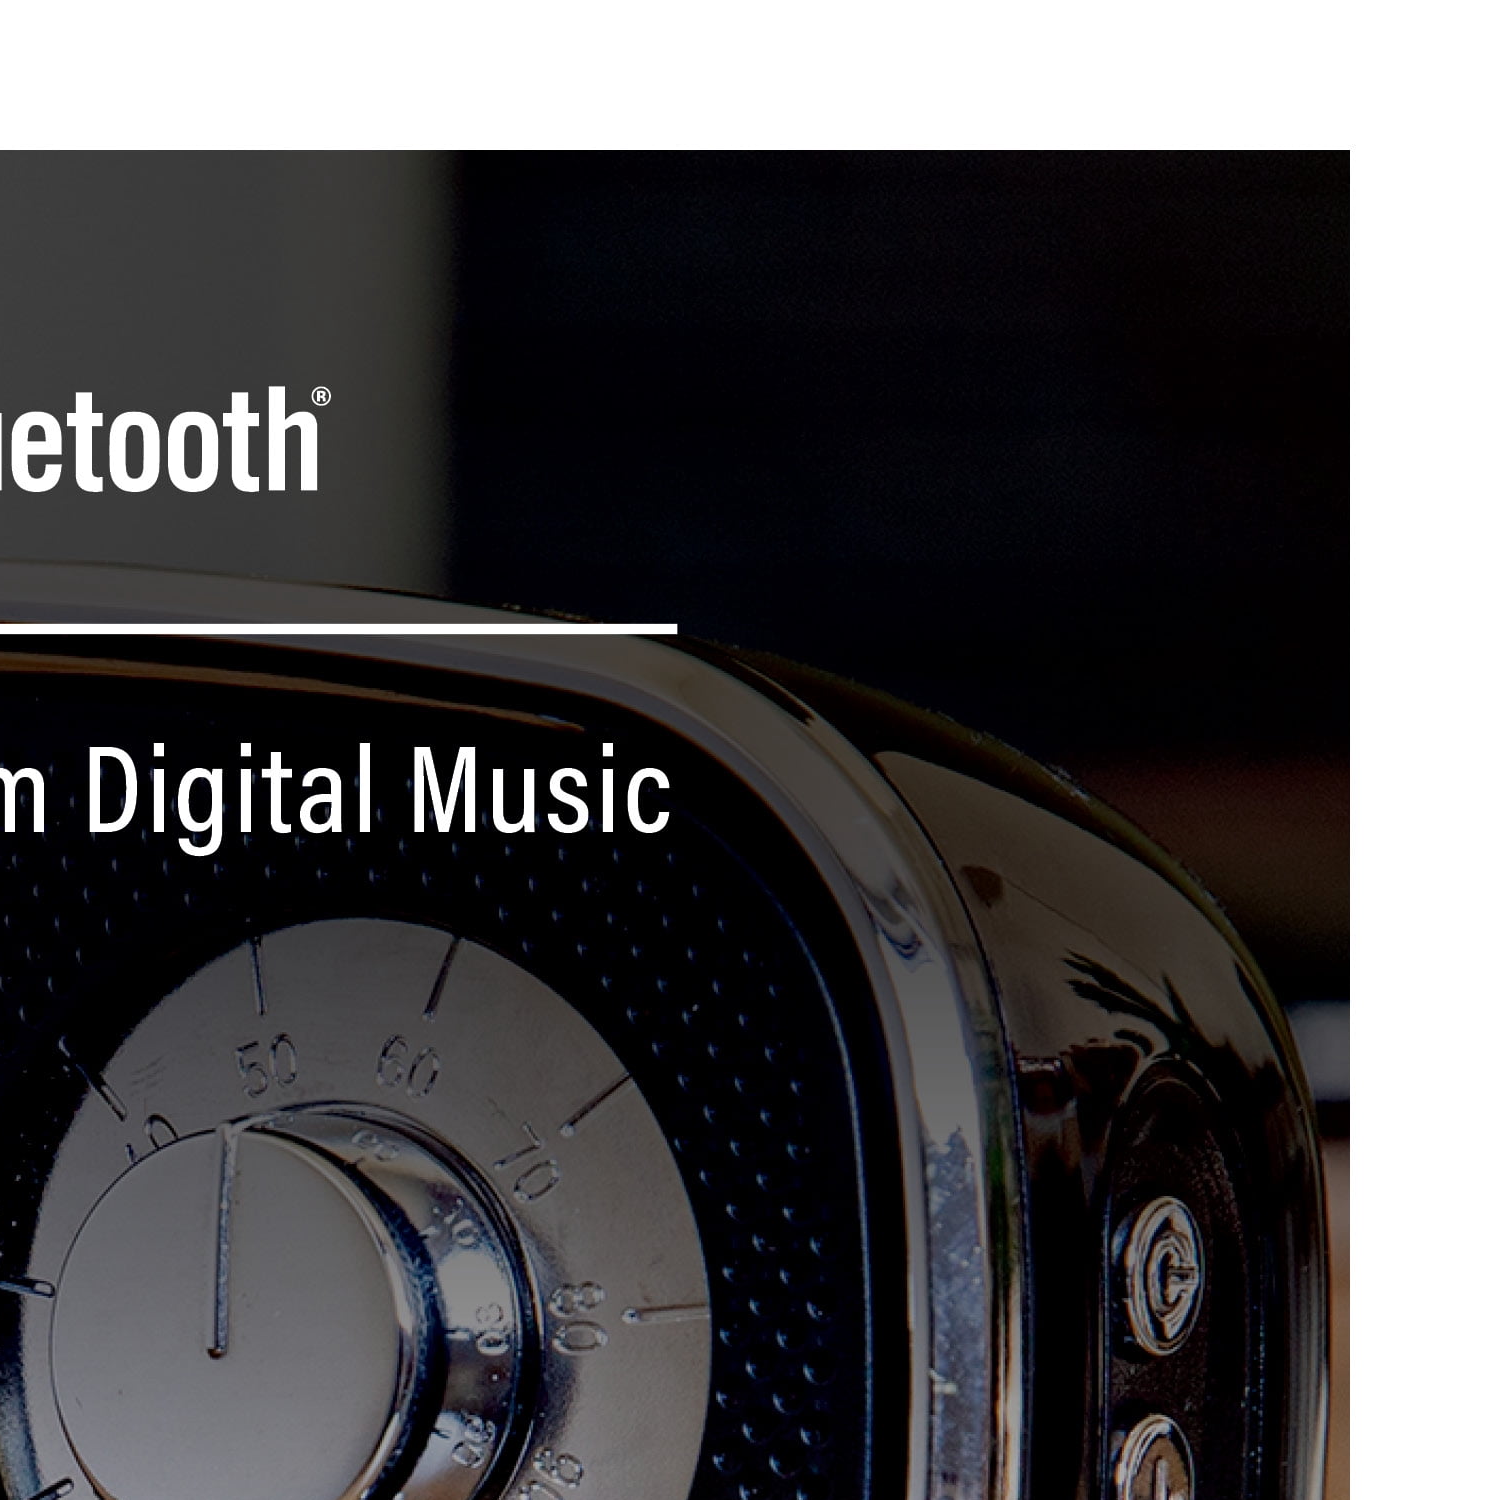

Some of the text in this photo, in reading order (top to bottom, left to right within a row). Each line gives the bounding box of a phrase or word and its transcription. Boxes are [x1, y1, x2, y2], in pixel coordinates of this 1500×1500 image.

[235, 1032, 299, 1097] 50
[375, 1034, 441, 1098] 60
[493, 1119, 562, 1201] 70
[549, 1280, 608, 1353] 80
